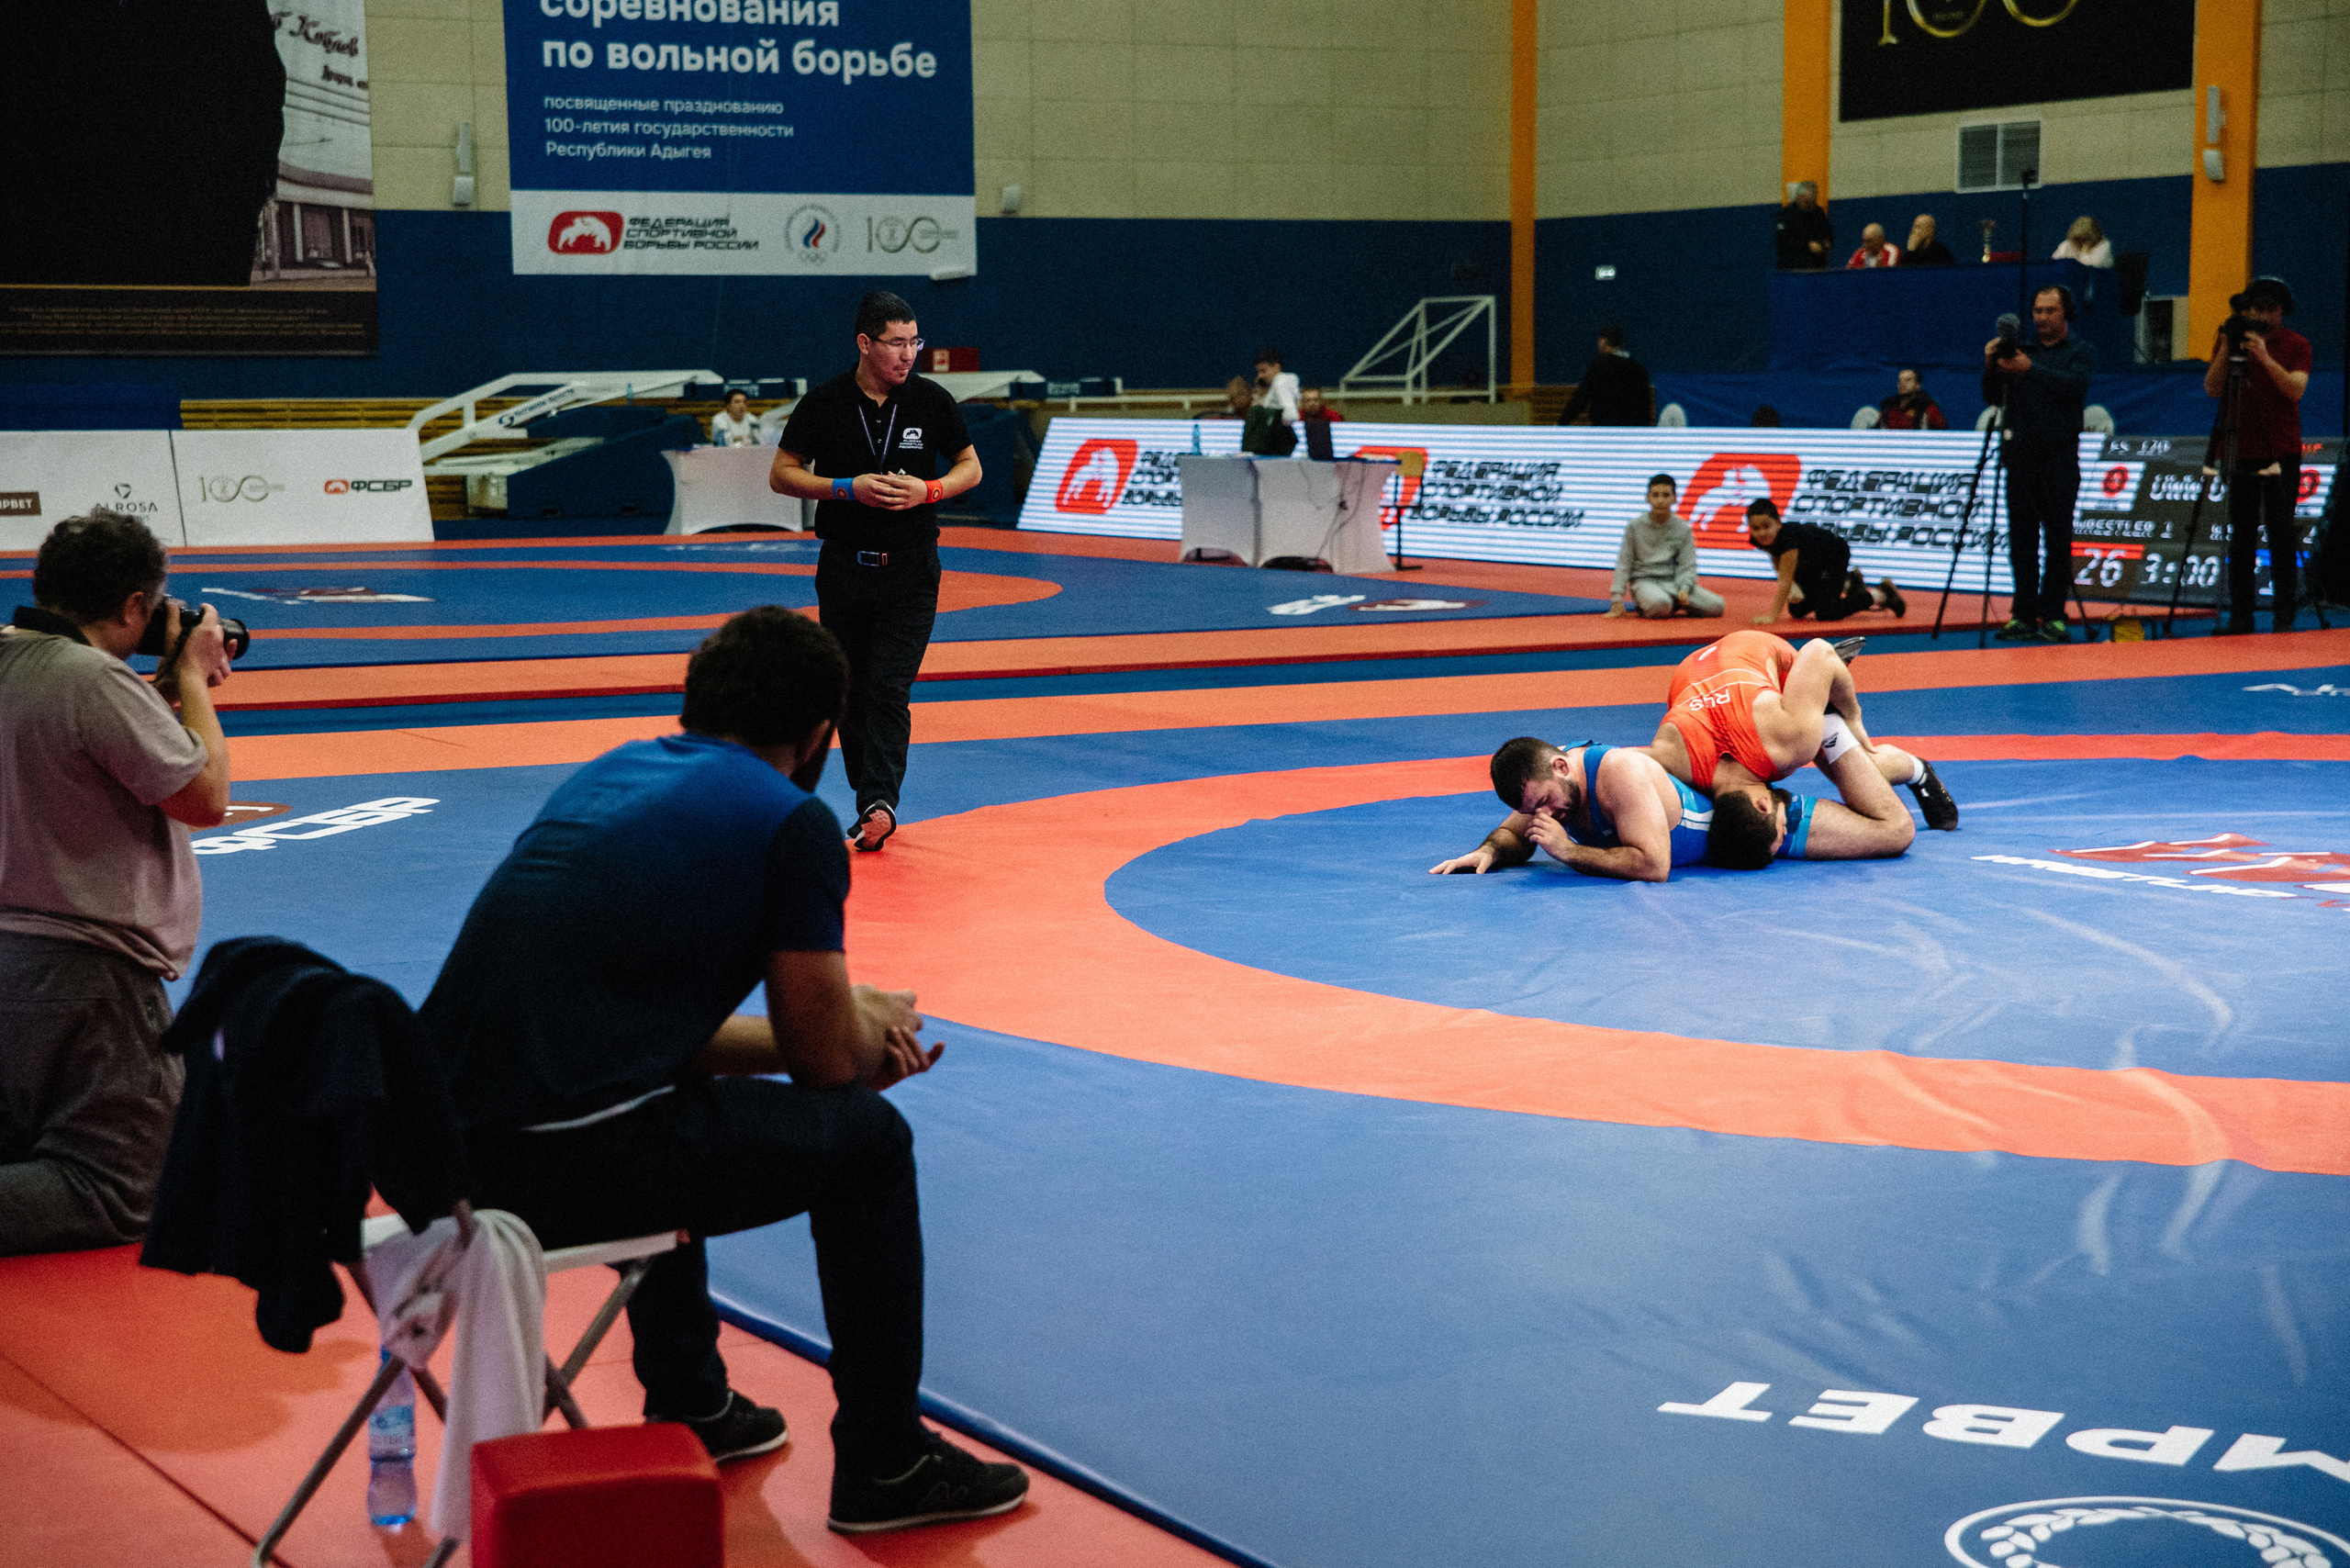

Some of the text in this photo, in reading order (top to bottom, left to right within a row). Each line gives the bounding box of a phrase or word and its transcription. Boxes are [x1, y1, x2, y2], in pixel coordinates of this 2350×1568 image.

[540, 0, 840, 28] соревнования
[543, 38, 937, 85] по вольной борьбе
[543, 96, 784, 115] посвященные празднованию
[544, 118, 795, 139] 100-летия государственности
[545, 140, 712, 161] Республики Адыгея
[626, 228, 738, 239] СПОРТИВНОЙ
[629, 218, 730, 229] ФЕДЕРАЦИЯ
[623, 241, 760, 251] БОРЬБЫ РОССИИ
[351, 480, 413, 493] ФСБР
[2074, 548, 2127, 588] 26
[1689, 689, 1730, 711] RUS
[190, 797, 441, 855] ФСБР
